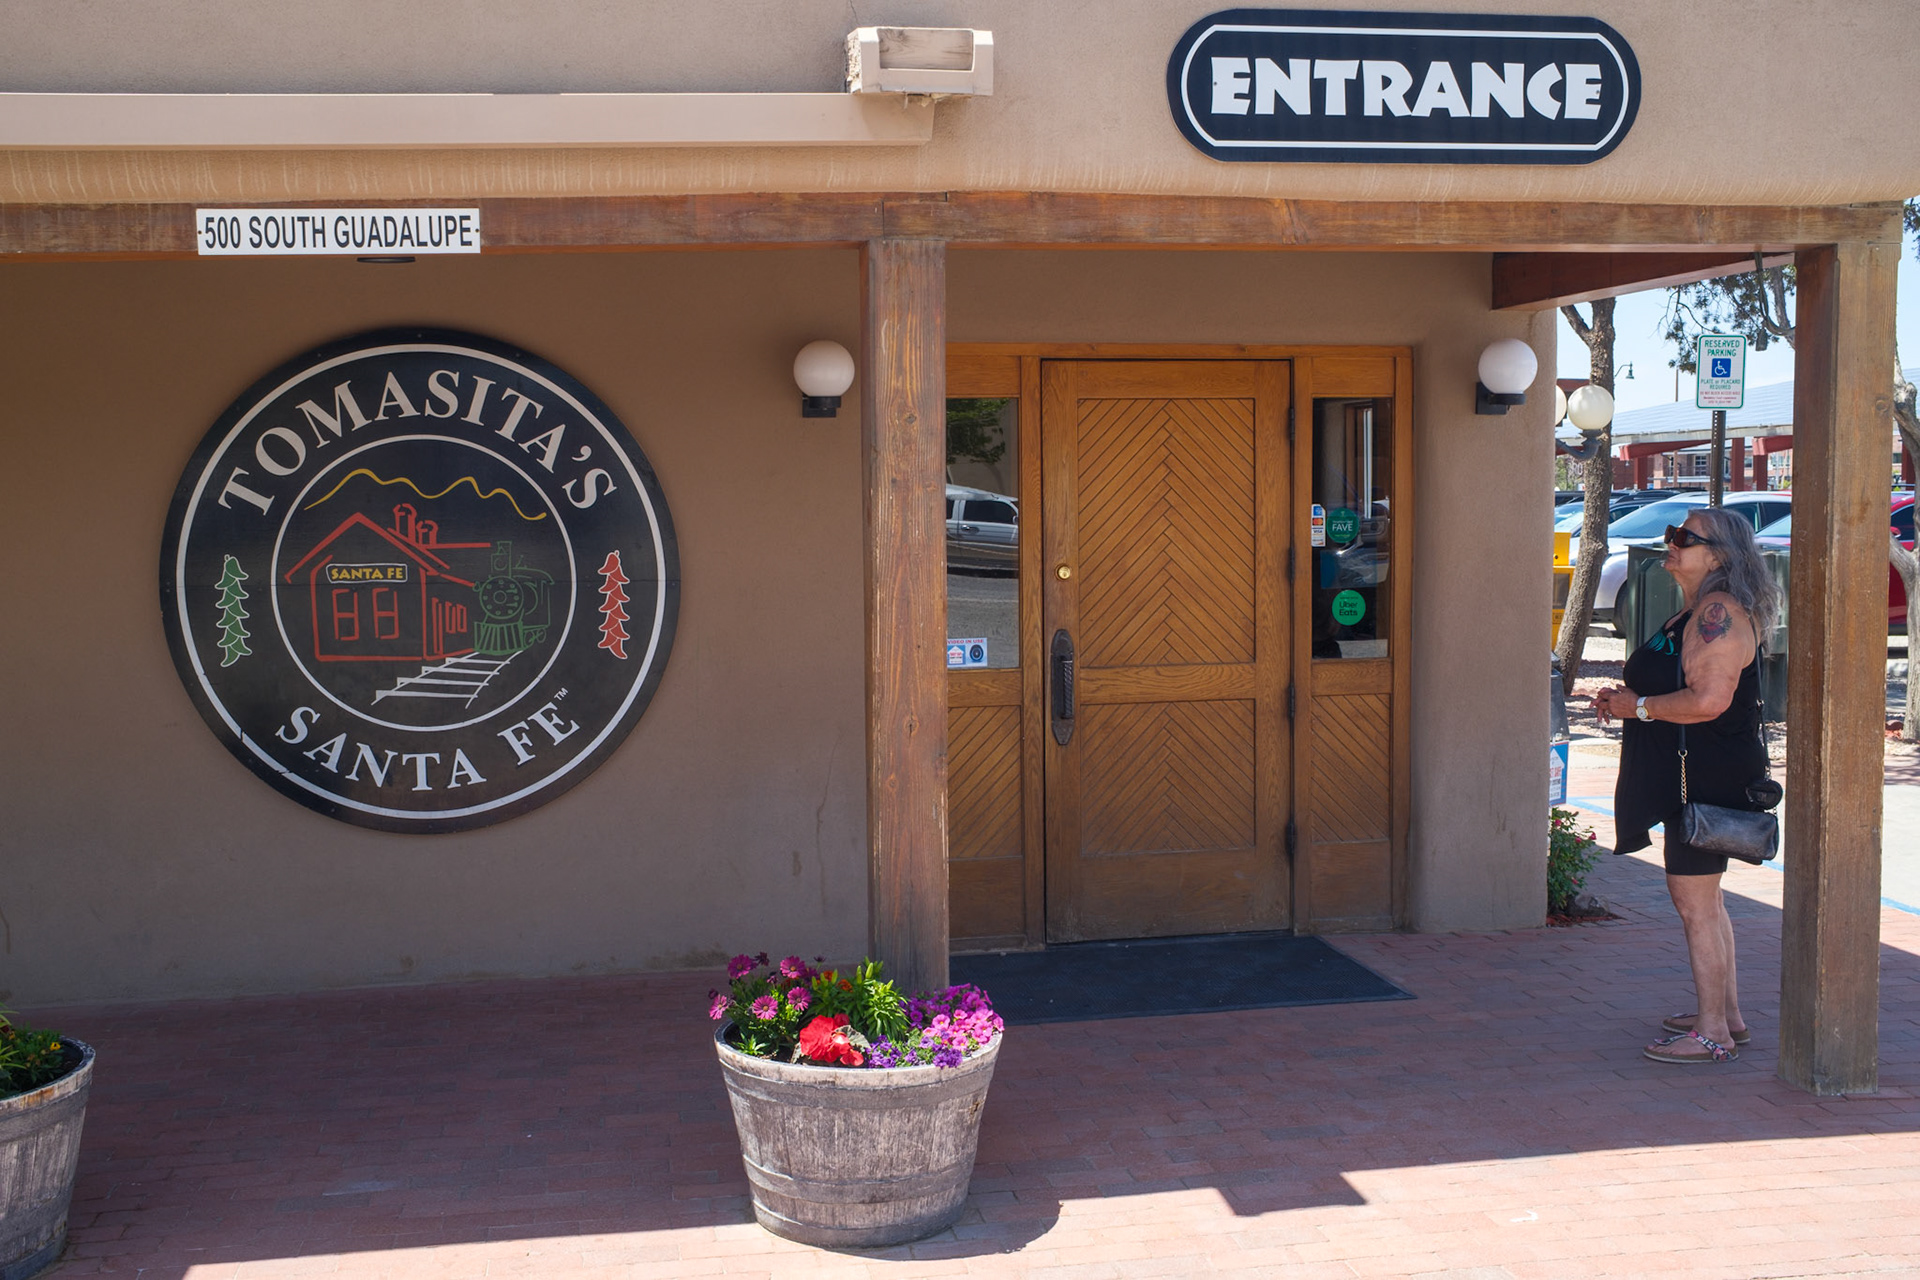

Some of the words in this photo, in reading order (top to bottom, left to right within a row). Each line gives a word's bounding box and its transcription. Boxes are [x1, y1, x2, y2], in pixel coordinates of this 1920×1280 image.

[1210, 56, 1602, 121] ENTRANCE
[204, 215, 242, 249] 500
[248, 215, 327, 249] SOUTH
[333, 214, 473, 248] GUADALUPE
[1704, 339, 1740, 348] RESERVED
[1707, 348, 1737, 357] PARKING
[218, 369, 618, 516] TOMASITA'S
[1332, 523, 1354, 532] FAVE
[331, 567, 384, 581] SANTA
[387, 567, 404, 580] FE
[1339, 600, 1359, 609] Uber
[274, 706, 488, 792] SANTA
